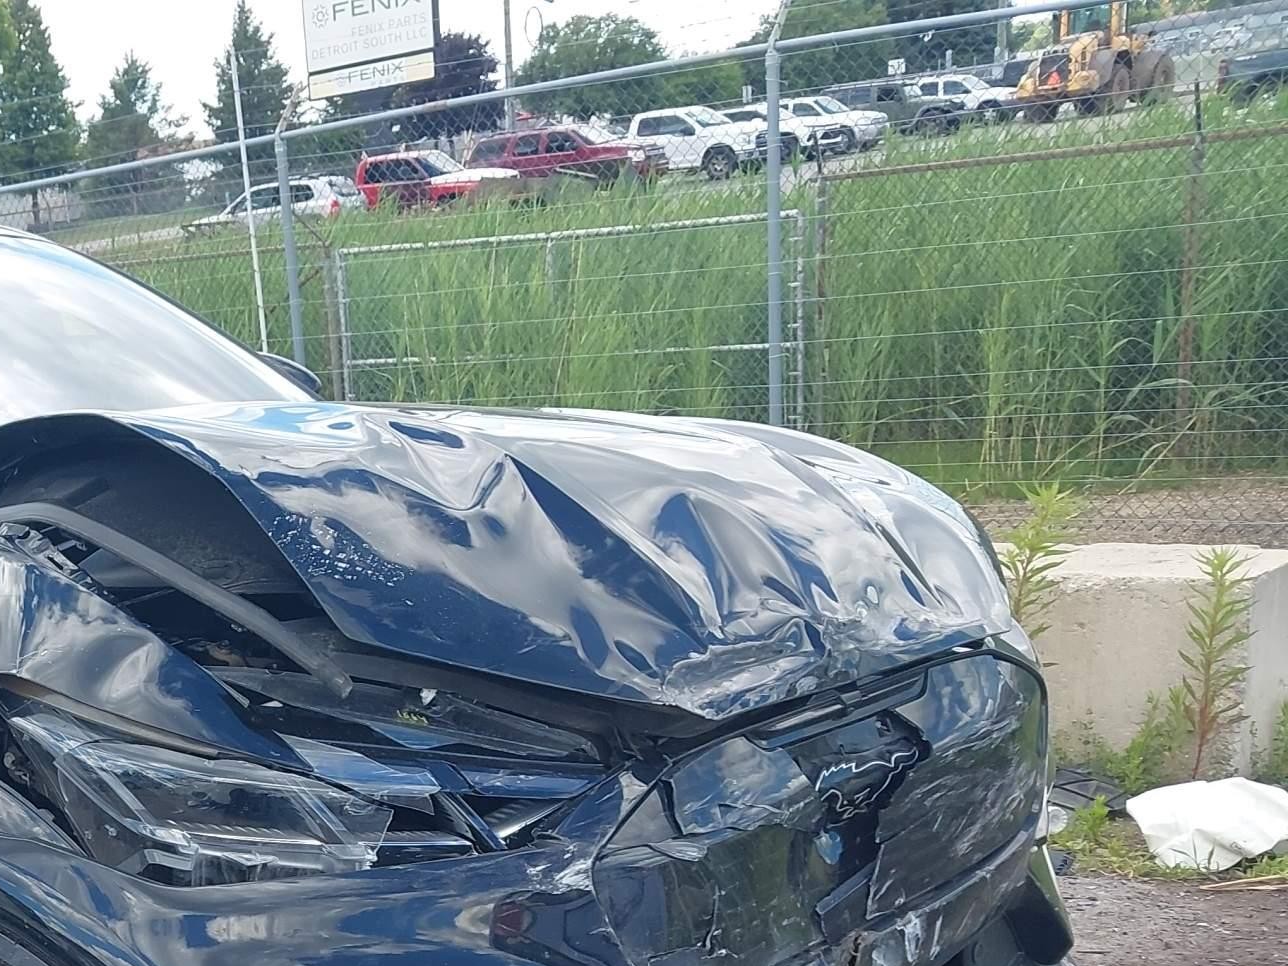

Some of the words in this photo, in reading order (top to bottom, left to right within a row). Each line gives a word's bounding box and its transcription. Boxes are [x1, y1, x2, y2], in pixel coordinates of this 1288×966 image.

[333, 0, 423, 22] FEN
[351, 22, 385, 37] FENIX
[388, 11, 426, 29] PARTS
[311, 40, 359, 60] DETROIT
[362, 32, 402, 49] SOUTH
[406, 26, 427, 42] LLC
[348, 60, 404, 83] FENIX
